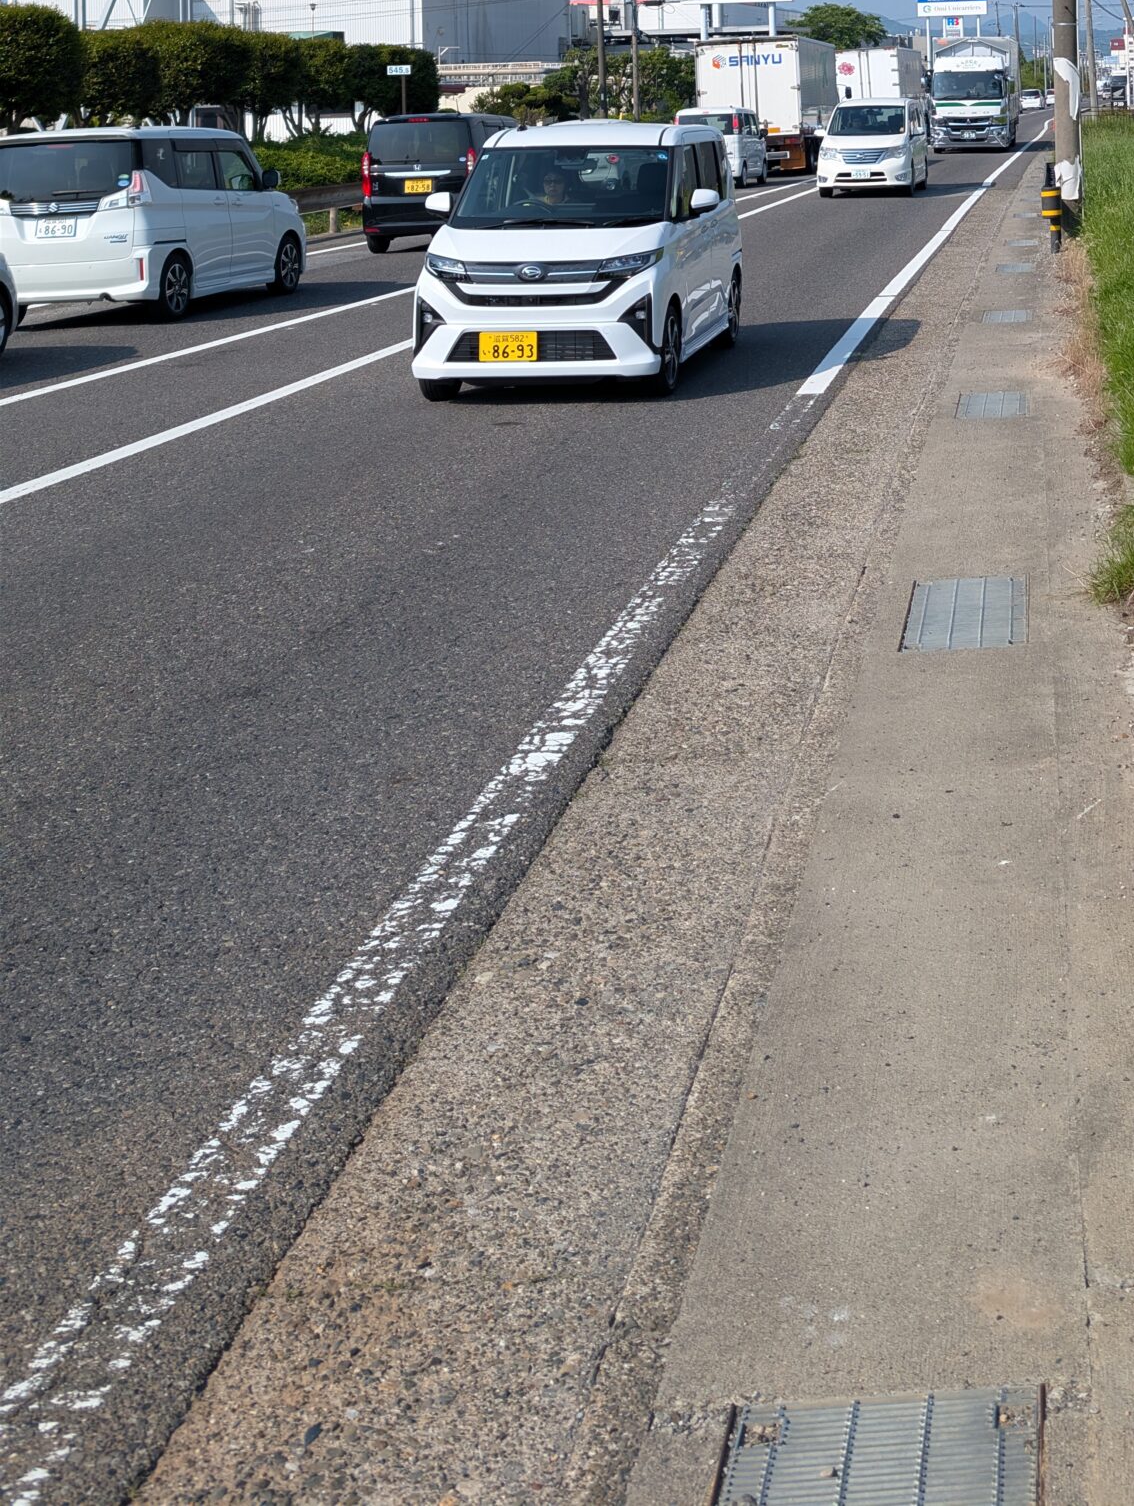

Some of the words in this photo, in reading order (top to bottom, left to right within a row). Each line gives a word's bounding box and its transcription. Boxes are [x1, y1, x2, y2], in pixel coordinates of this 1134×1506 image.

[728, 54, 782, 67] SANYU
[44, 224, 73, 236] 86-90
[492, 344, 534, 359] 86-93
